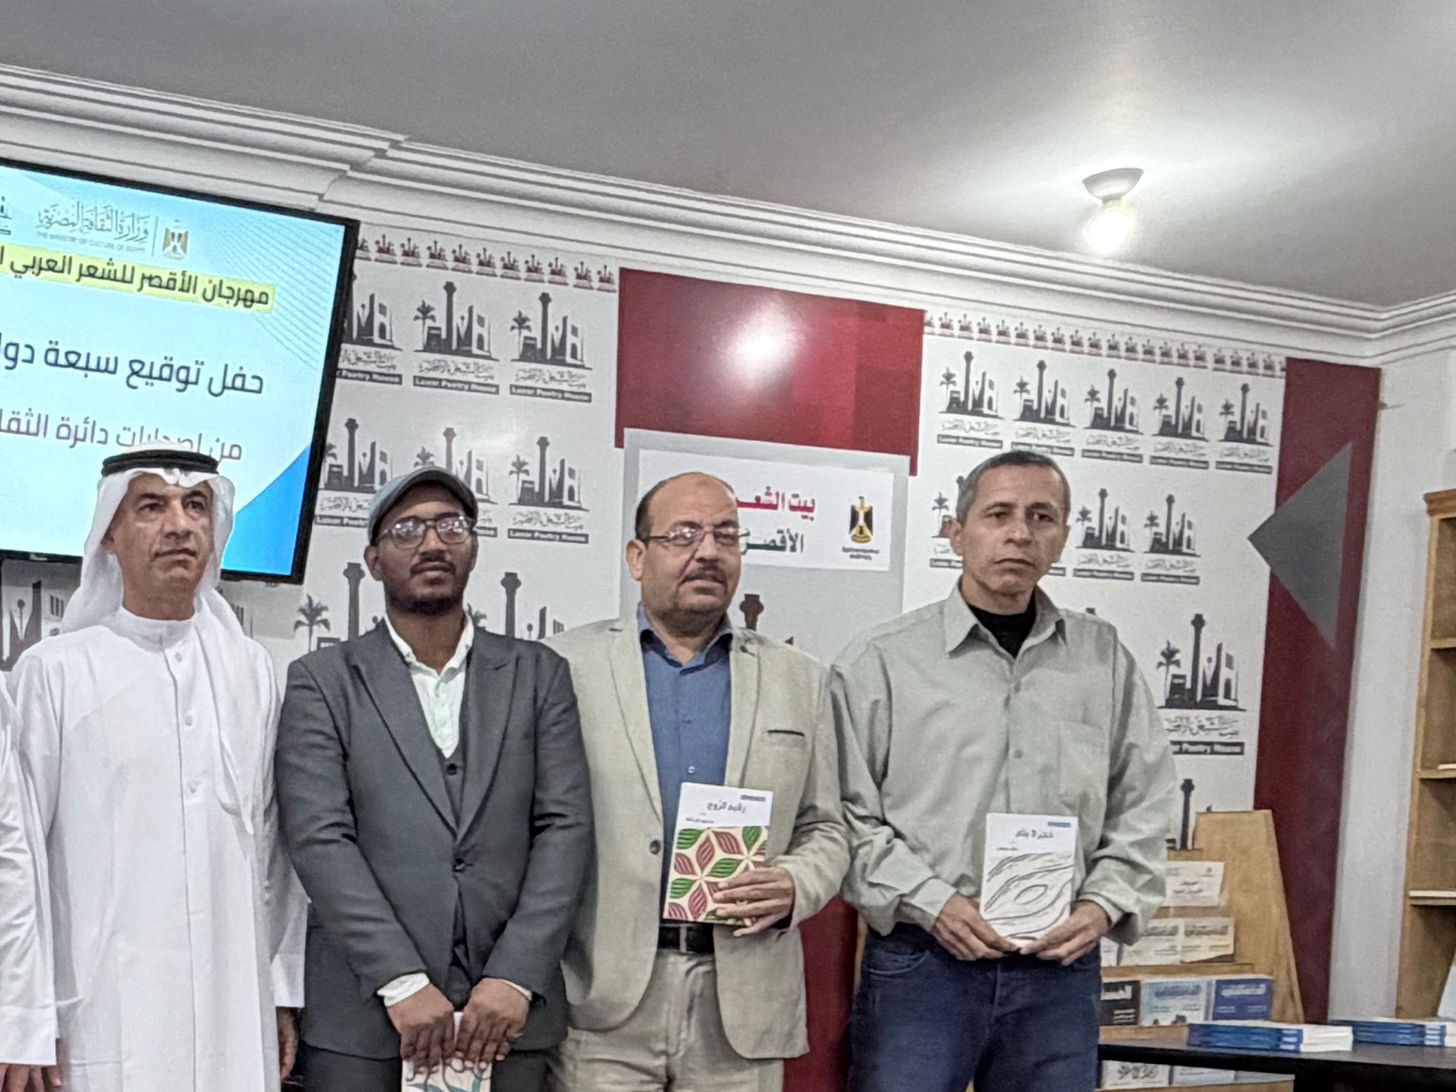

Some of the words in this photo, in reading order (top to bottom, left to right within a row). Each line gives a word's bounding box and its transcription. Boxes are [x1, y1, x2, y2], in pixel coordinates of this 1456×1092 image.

[10, 254, 72, 278] العربي
[76, 257, 135, 284] للشعر
[137, 269, 198, 295] الأقصر
[202, 279, 269, 308] مهرجان
[44, 340, 118, 378] سبعة
[126, 356, 205, 392] توقيع
[208, 363, 264, 398] حفل
[56, 416, 108, 448] دائرة
[736, 486, 785, 511] الشع
[788, 492, 816, 520] بيت
